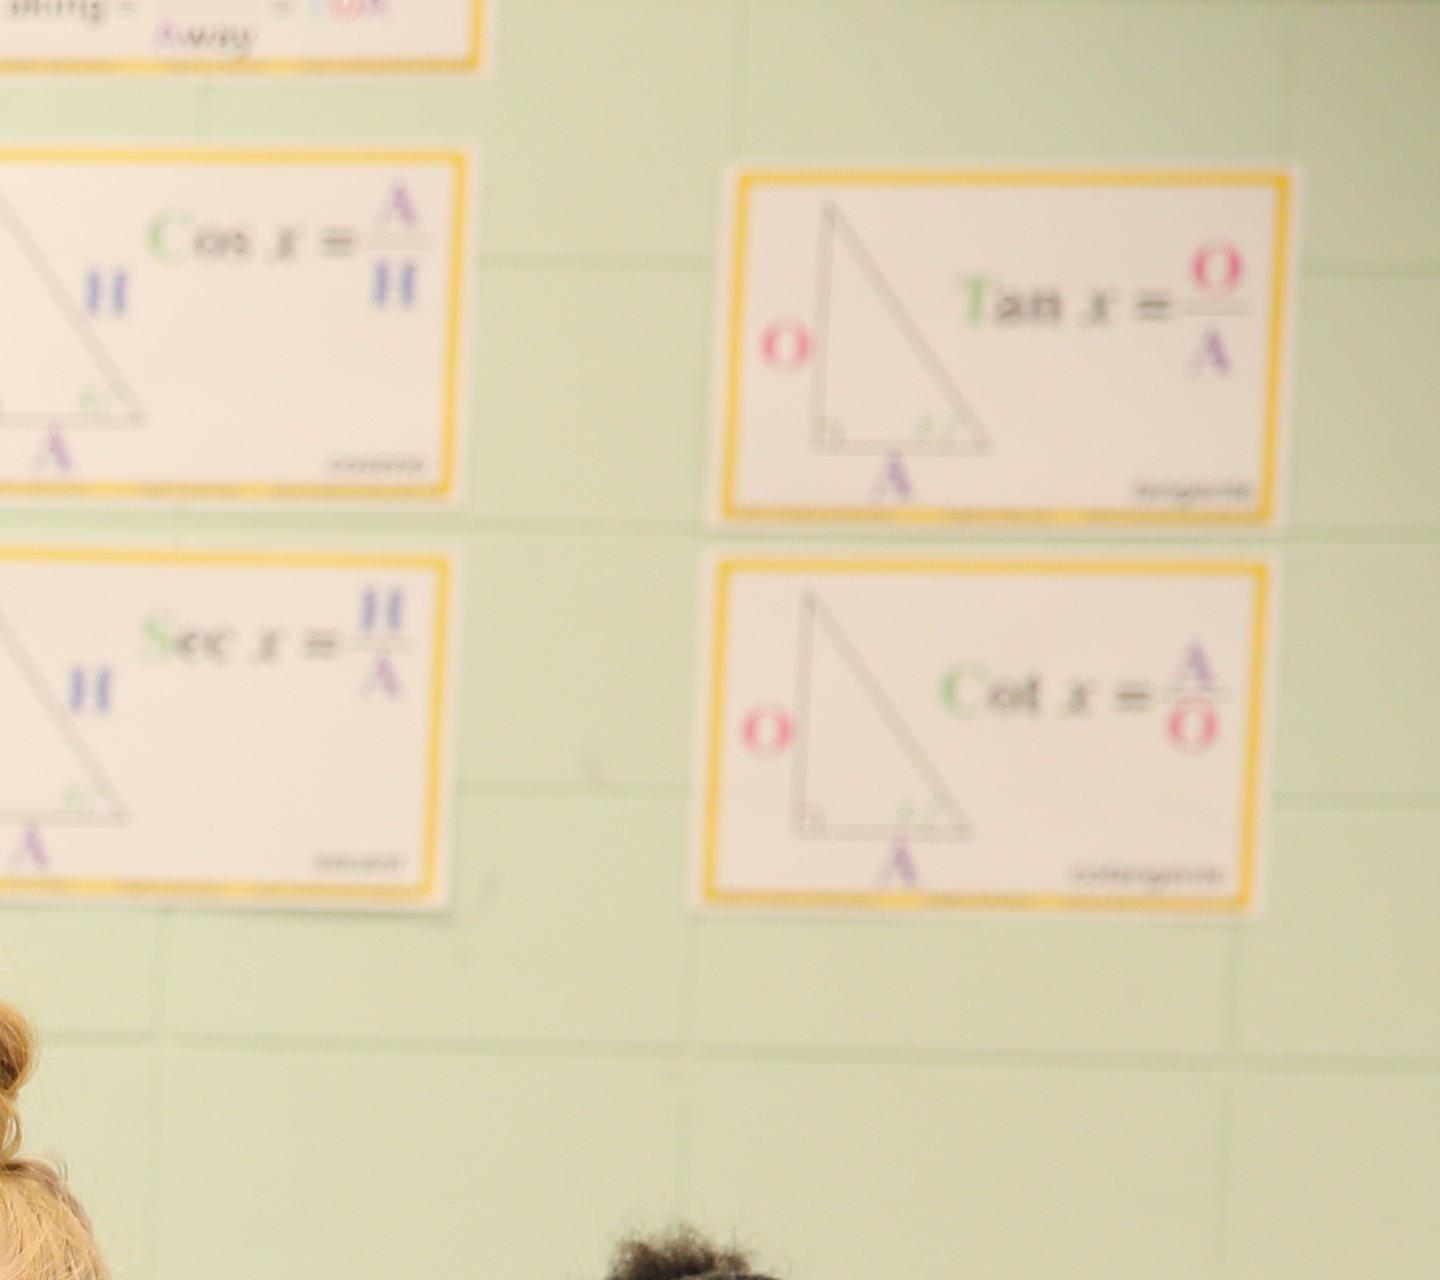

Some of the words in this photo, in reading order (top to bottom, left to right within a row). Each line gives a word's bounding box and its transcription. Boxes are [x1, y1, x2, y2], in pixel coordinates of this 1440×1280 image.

[147, 210, 251, 264] Cos
[955, 274, 1062, 327] Tan
[138, 612, 229, 665] Sec
[938, 663, 1042, 718] Cot
